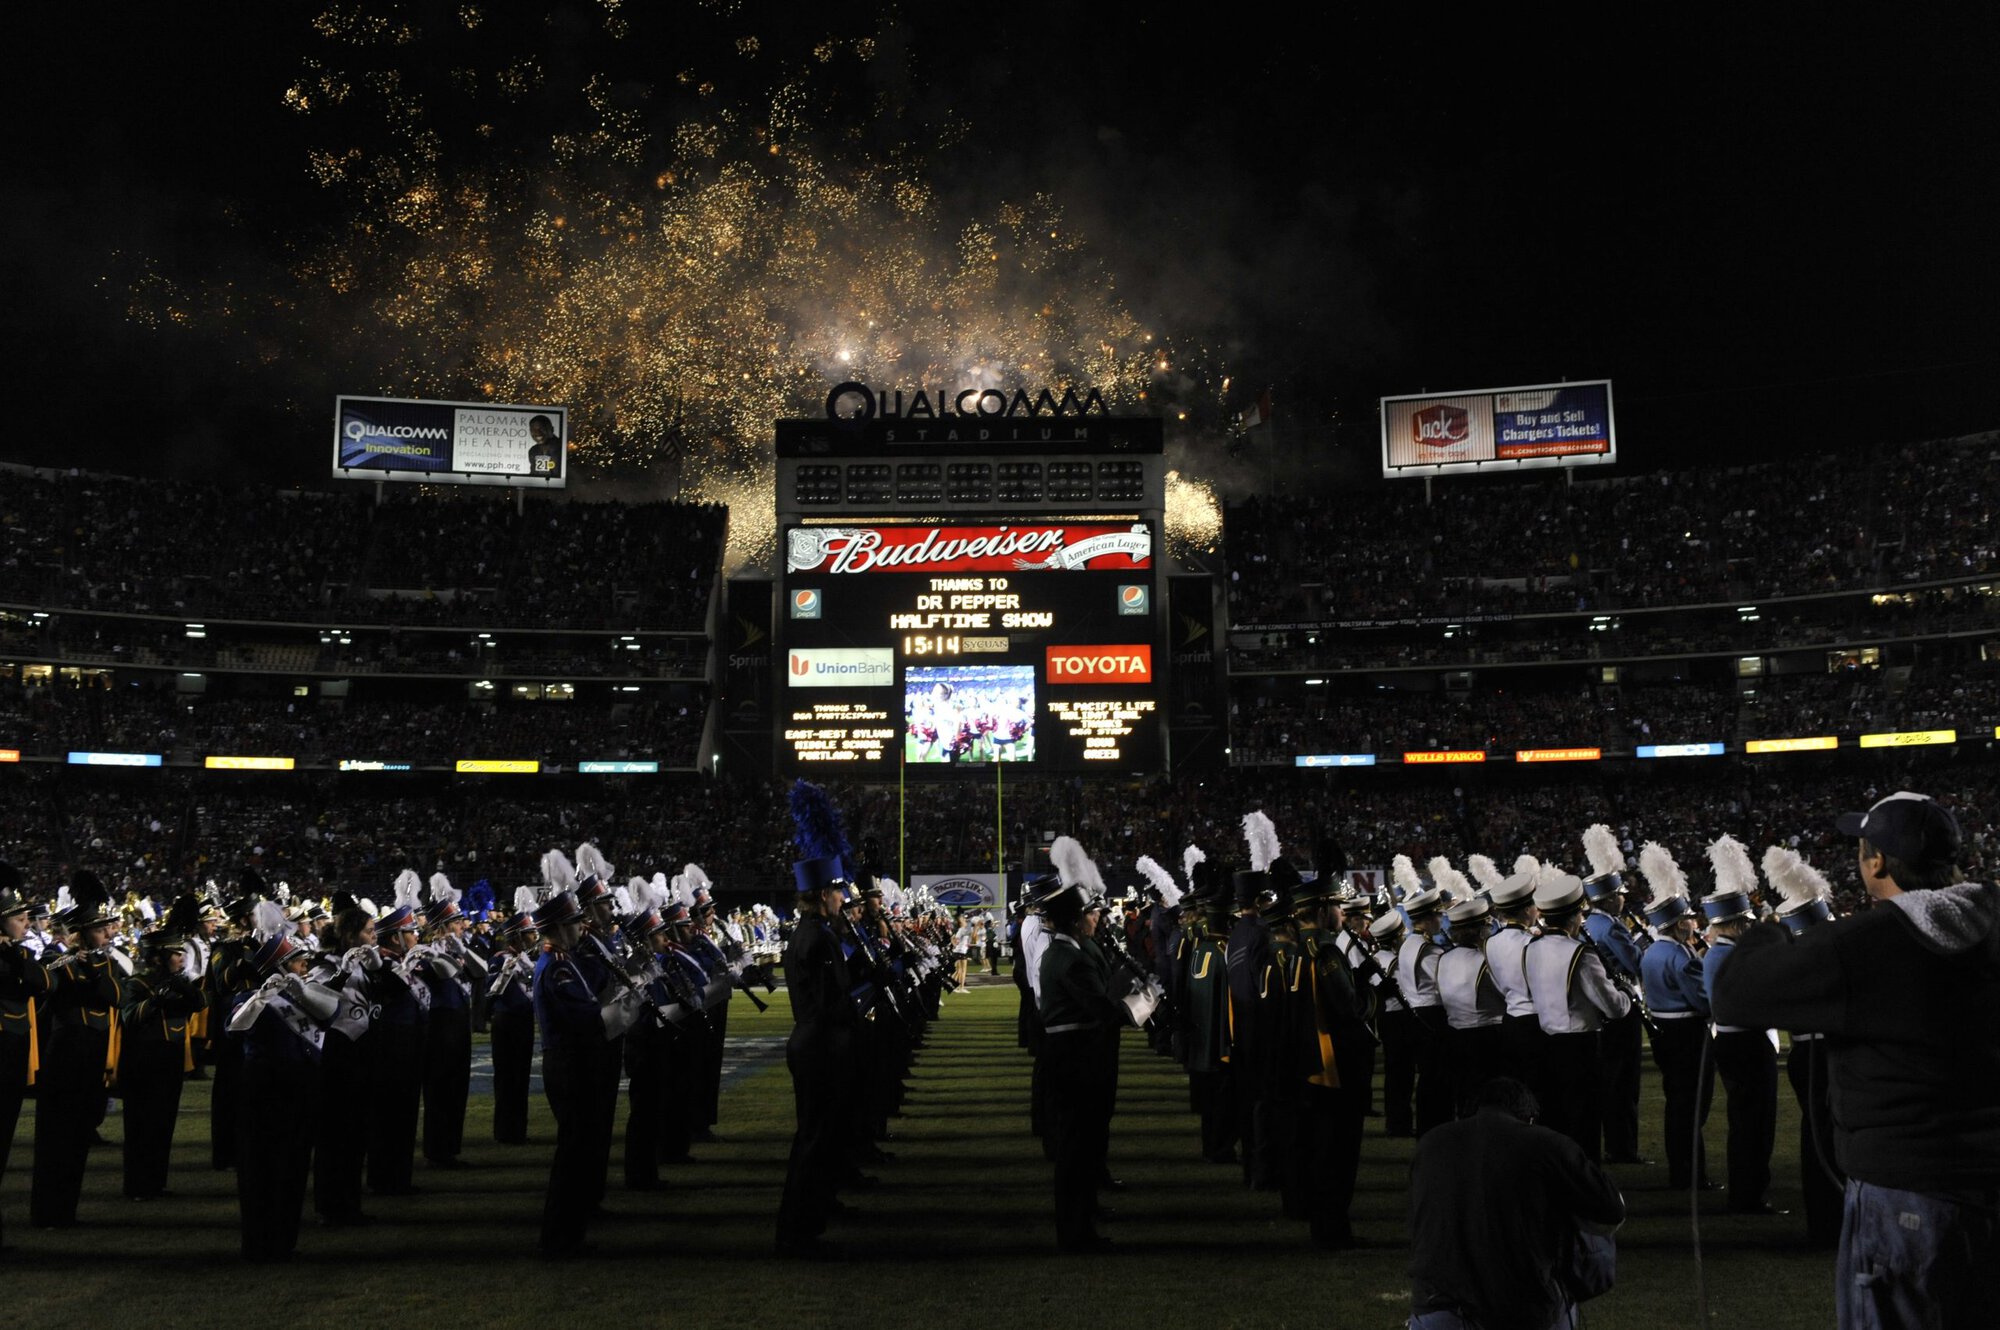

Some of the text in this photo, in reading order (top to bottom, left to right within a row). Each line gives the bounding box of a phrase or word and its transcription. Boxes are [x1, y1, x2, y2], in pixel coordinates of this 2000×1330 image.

[826, 382, 1110, 431] QUALCOMM
[460, 414, 527, 427] PALOMAR
[1517, 410, 1585, 426] Buy and Sell
[346, 421, 447, 442] QUALCOMM
[460, 426, 527, 438] POMERADO
[1415, 409, 1467, 442] Jack
[1503, 423, 1600, 441] Chargers Tickets!
[886, 428, 1089, 442] STADIUM
[365, 444, 431, 455] Innovation
[459, 437, 526, 449] HEALTH
[465, 461, 520, 471] www.pph.org
[820, 526, 1064, 573] Budweiser
[1067, 539, 1148, 563] American Lager
[930, 578, 1008, 591] THANKS TO
[917, 594, 1020, 610] DR PEPPER
[890, 612, 1053, 628] HALFTIME SHOW
[905, 636, 960, 654] 15:14
[729, 654, 768, 670] Sprint
[1172, 651, 1213, 664] Sprint
[816, 663, 891, 674] UnionBank
[1051, 656, 1147, 674] TOYOTA
[854, 704, 867, 712] TO
[1073, 702, 1122, 711] PACIFIC
[1126, 701, 1155, 711] LIFE
[816, 712, 887, 720] PARTICIPANTS
[785, 729, 847, 739] EAST-WEST
[798, 750, 859, 760] PORTLAND,
[1406, 752, 1483, 762] WELLS FARGO
[934, 880, 985, 894] PACIFIC LIFE
[1352, 872, 1376, 893] N
